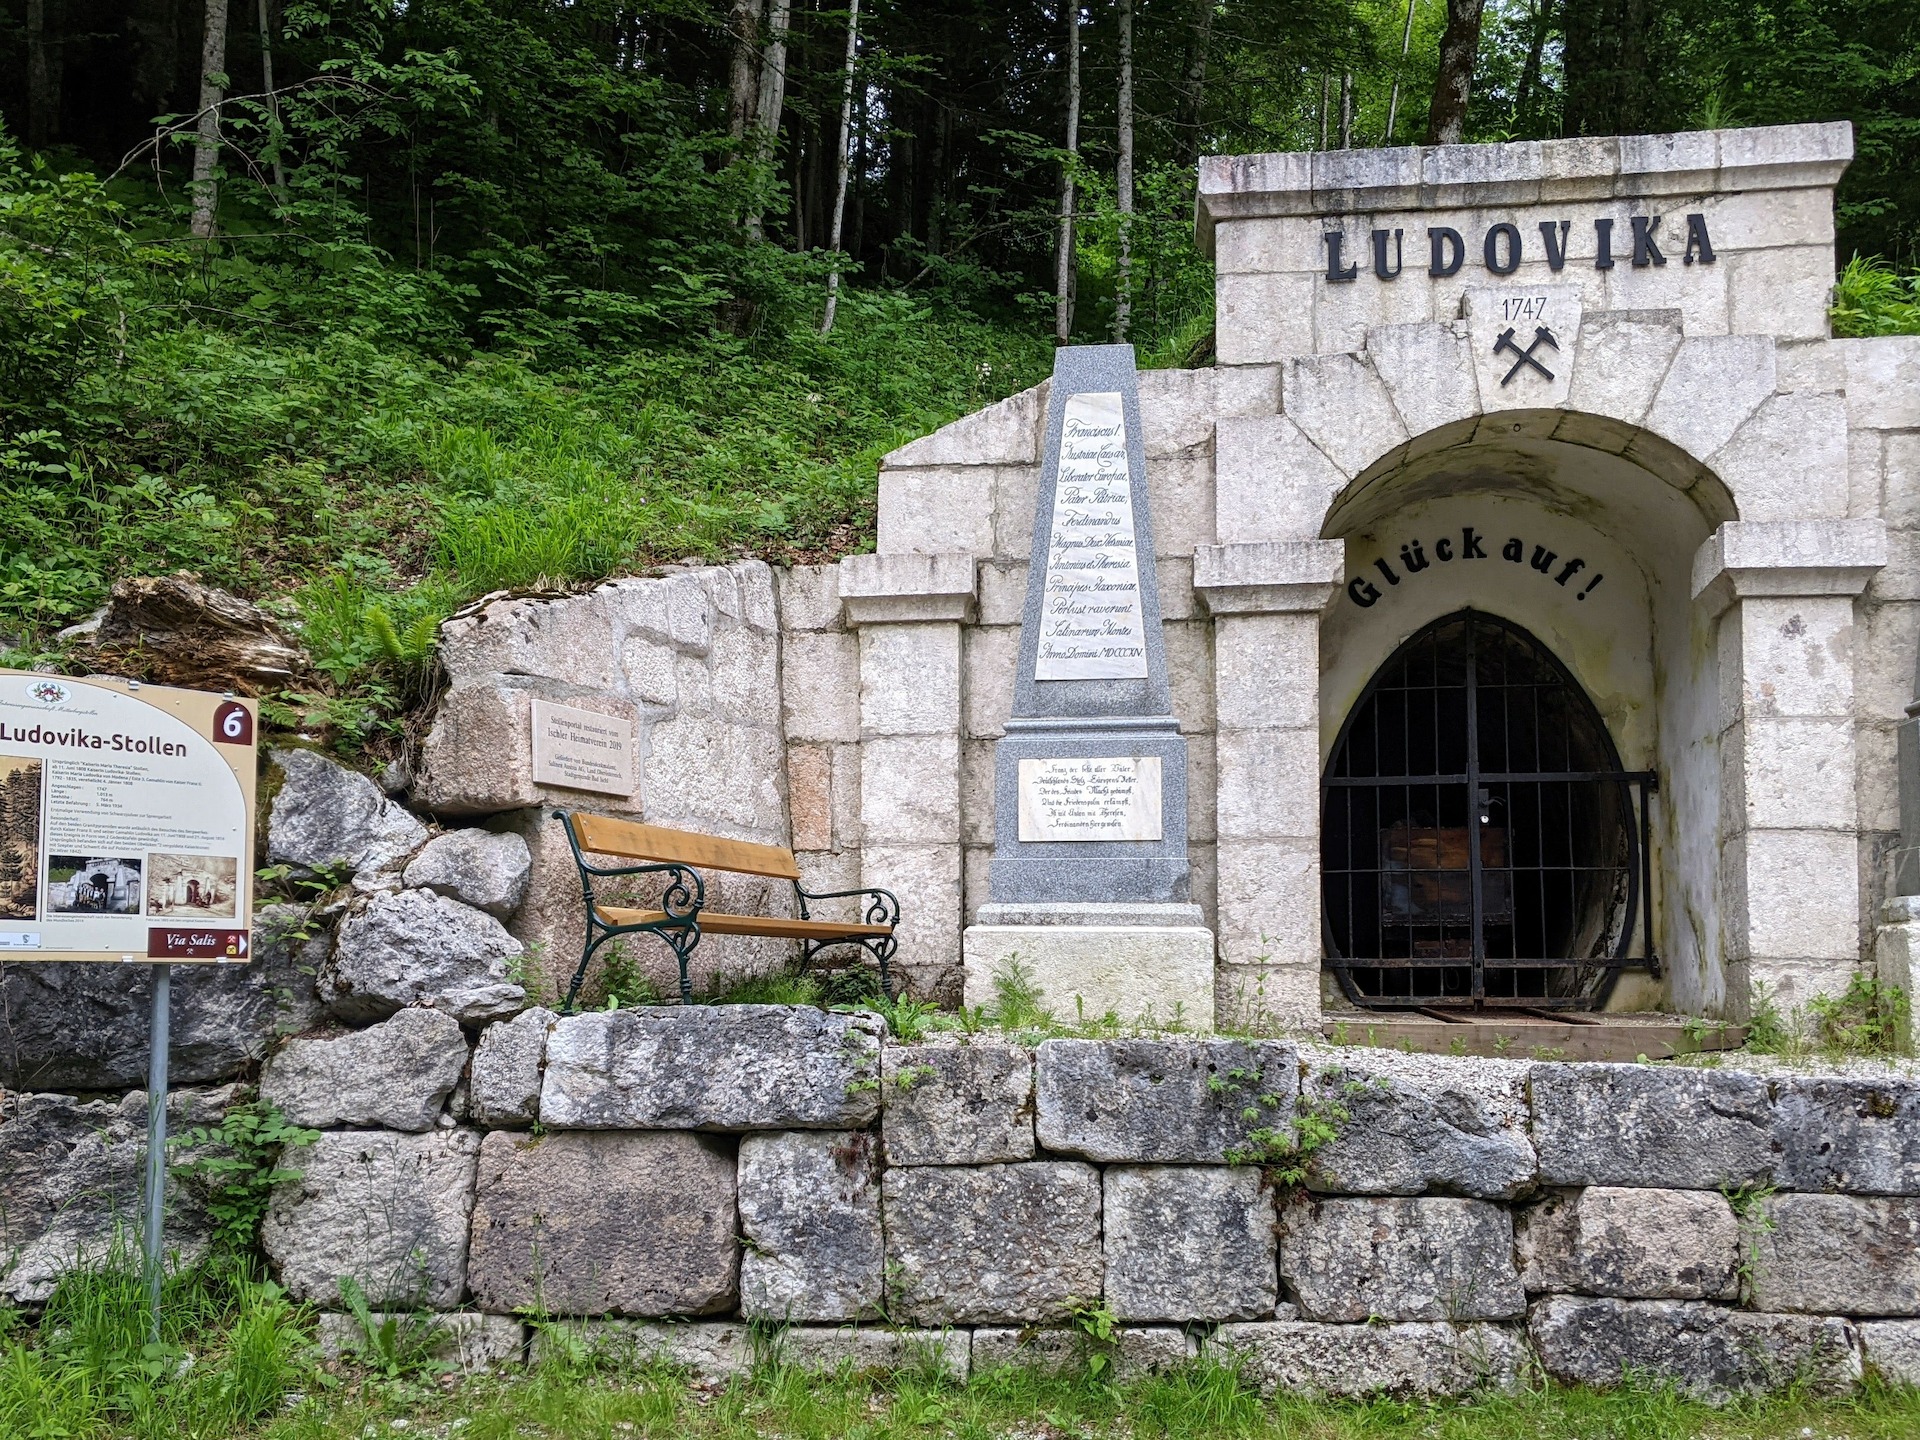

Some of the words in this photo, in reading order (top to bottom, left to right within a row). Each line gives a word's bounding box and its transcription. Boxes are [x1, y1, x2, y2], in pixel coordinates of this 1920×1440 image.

[1325, 213, 1717, 281] LUDOVIKA
[1502, 297, 1547, 321] 1747
[1060, 486, 1088, 504] Pater
[1062, 509, 1121, 526] Ferdinandus
[1093, 553, 1131, 570] Theresia
[1348, 527, 1487, 608] Glück
[1502, 537, 1603, 601] auf!
[223, 711, 243, 737] 6
[0, 722, 187, 757] Ludovika-Stollen
[547, 727, 568, 739] Ischler
[569, 731, 607, 748] Heimatverein
[609, 739, 622, 751] 2019
[167, 933, 186, 945] Via
[189, 934, 216, 946] Salis
